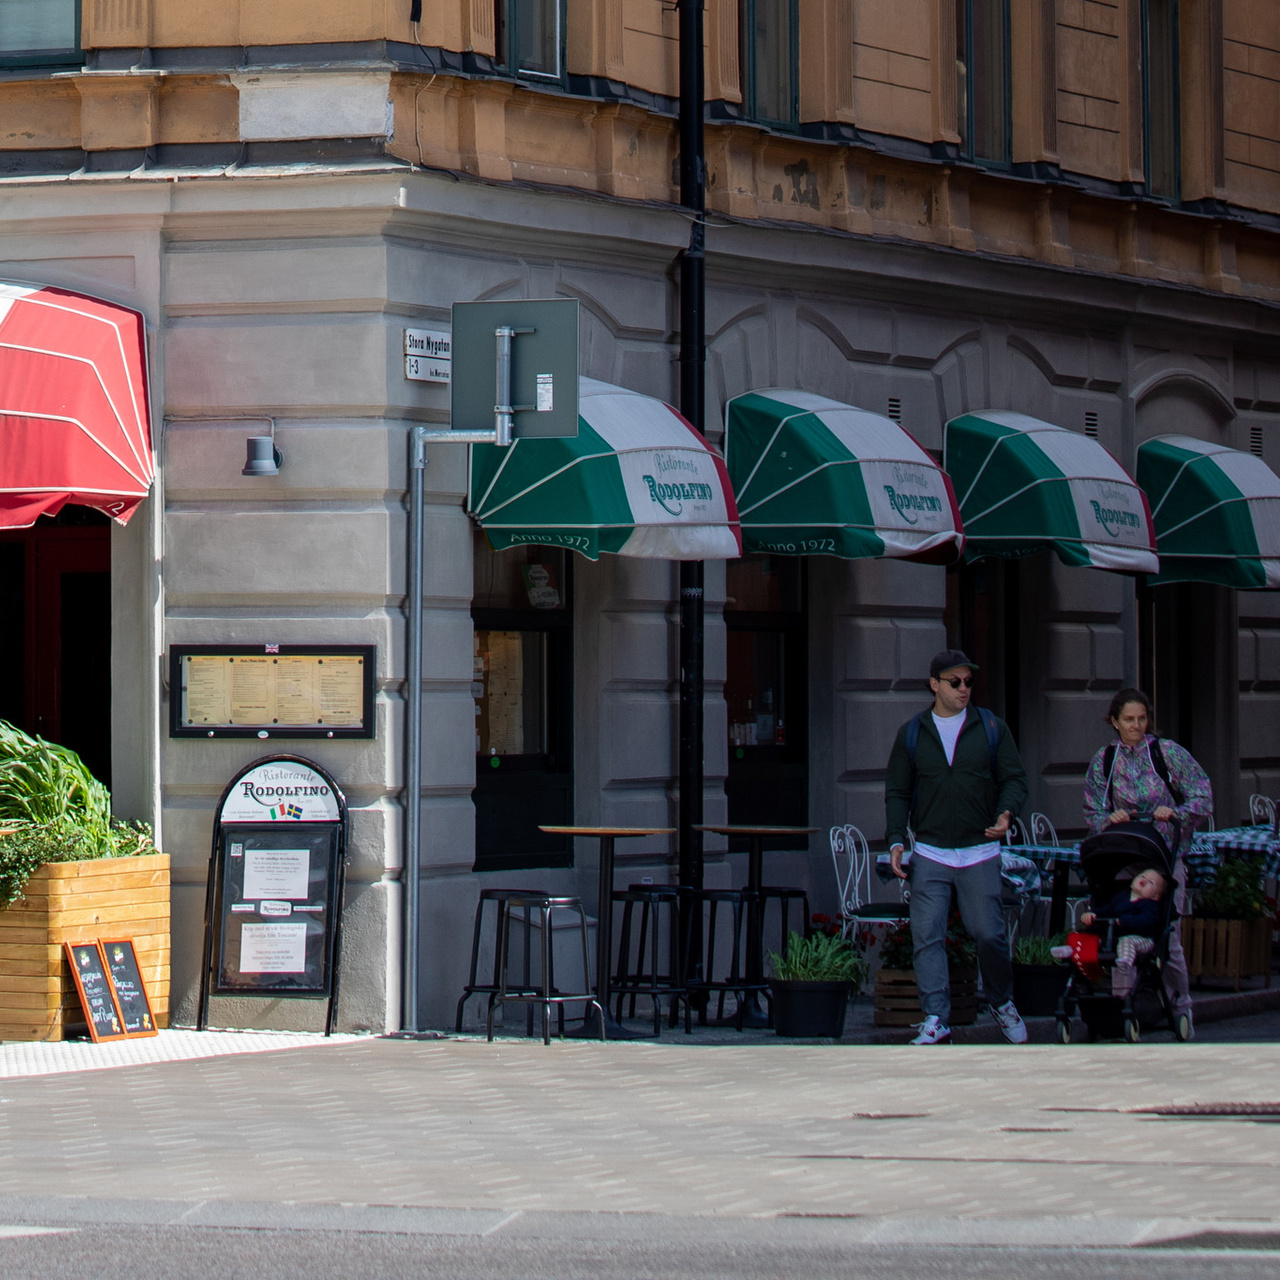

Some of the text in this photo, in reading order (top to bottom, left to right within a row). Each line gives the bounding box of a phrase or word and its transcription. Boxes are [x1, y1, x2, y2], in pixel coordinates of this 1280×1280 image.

[408, 334, 450, 355] Stora Nygatan
[408, 358, 419, 375] 1-3
[654, 453, 699, 478] Ristorante
[643, 475, 713, 516] RODOLFINO
[883, 485, 942, 524] RODOLFINO
[511, 534, 590, 550] Anno 1972
[759, 538, 835, 552] Anno 1972
[259, 769, 317, 783] Ristorante
[240, 781, 331, 807] RODOLFINO
